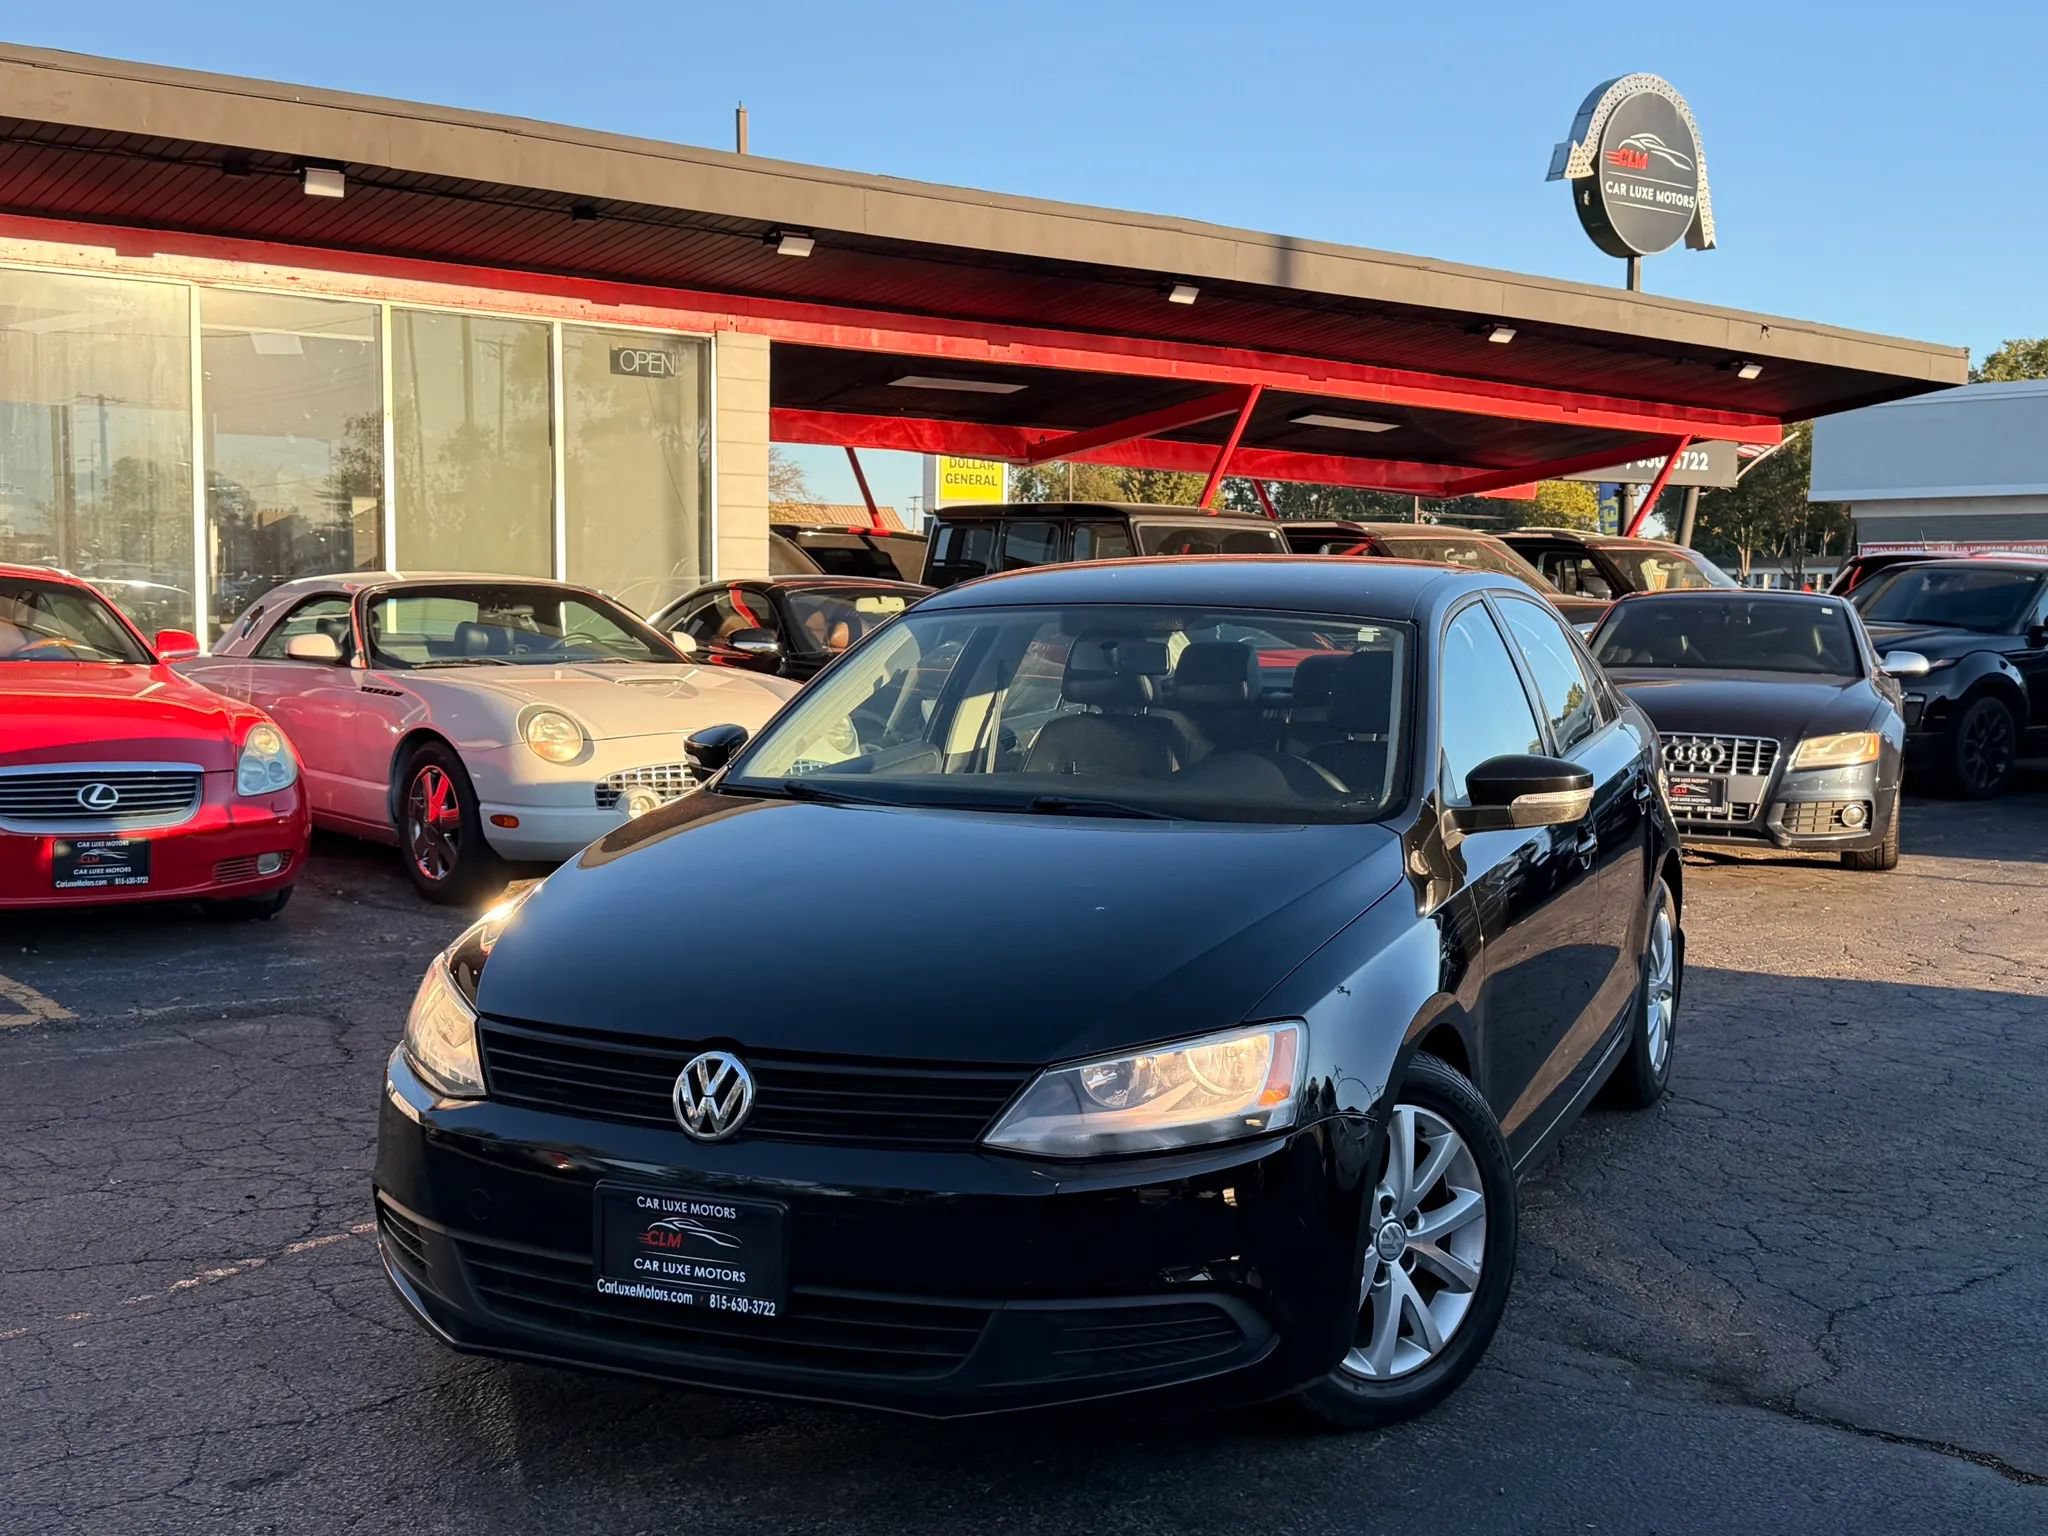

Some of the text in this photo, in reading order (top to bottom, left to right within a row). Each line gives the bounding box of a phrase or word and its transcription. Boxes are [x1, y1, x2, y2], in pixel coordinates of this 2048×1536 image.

[1618, 148, 1649, 169] CLM
[1605, 181, 1695, 209] CAR LUXE MOTORS
[620, 349, 675, 375] OPEN
[949, 458, 995, 470] DOLLAR
[945, 472, 998, 486] GENERAL
[56, 879, 107, 888] CarLuxeMotors.com
[636, 1196, 736, 1219] CAR LUXE MOTORS
[649, 1230, 683, 1248] CLM
[633, 1258, 746, 1282] CAR LUXE MOTORS
[597, 1278, 776, 1317] CarLuxeMotors.com 815-630-3722
